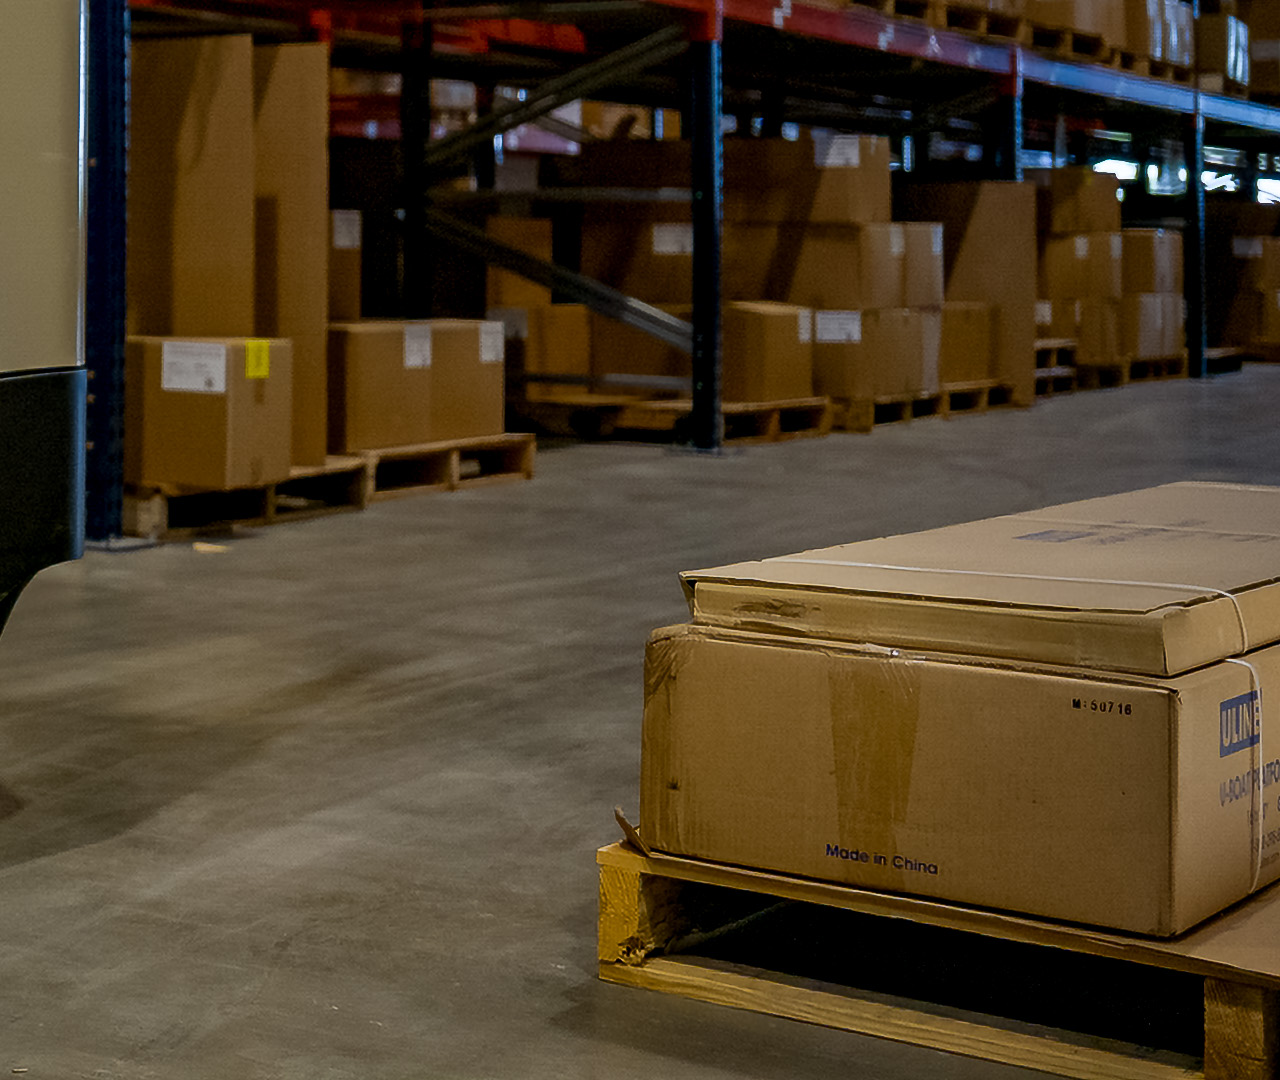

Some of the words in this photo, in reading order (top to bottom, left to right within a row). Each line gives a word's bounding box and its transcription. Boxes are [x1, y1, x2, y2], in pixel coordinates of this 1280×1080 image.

[825, 843, 869, 863] Made
[873, 852, 887, 866] in
[892, 855, 938, 875] China
